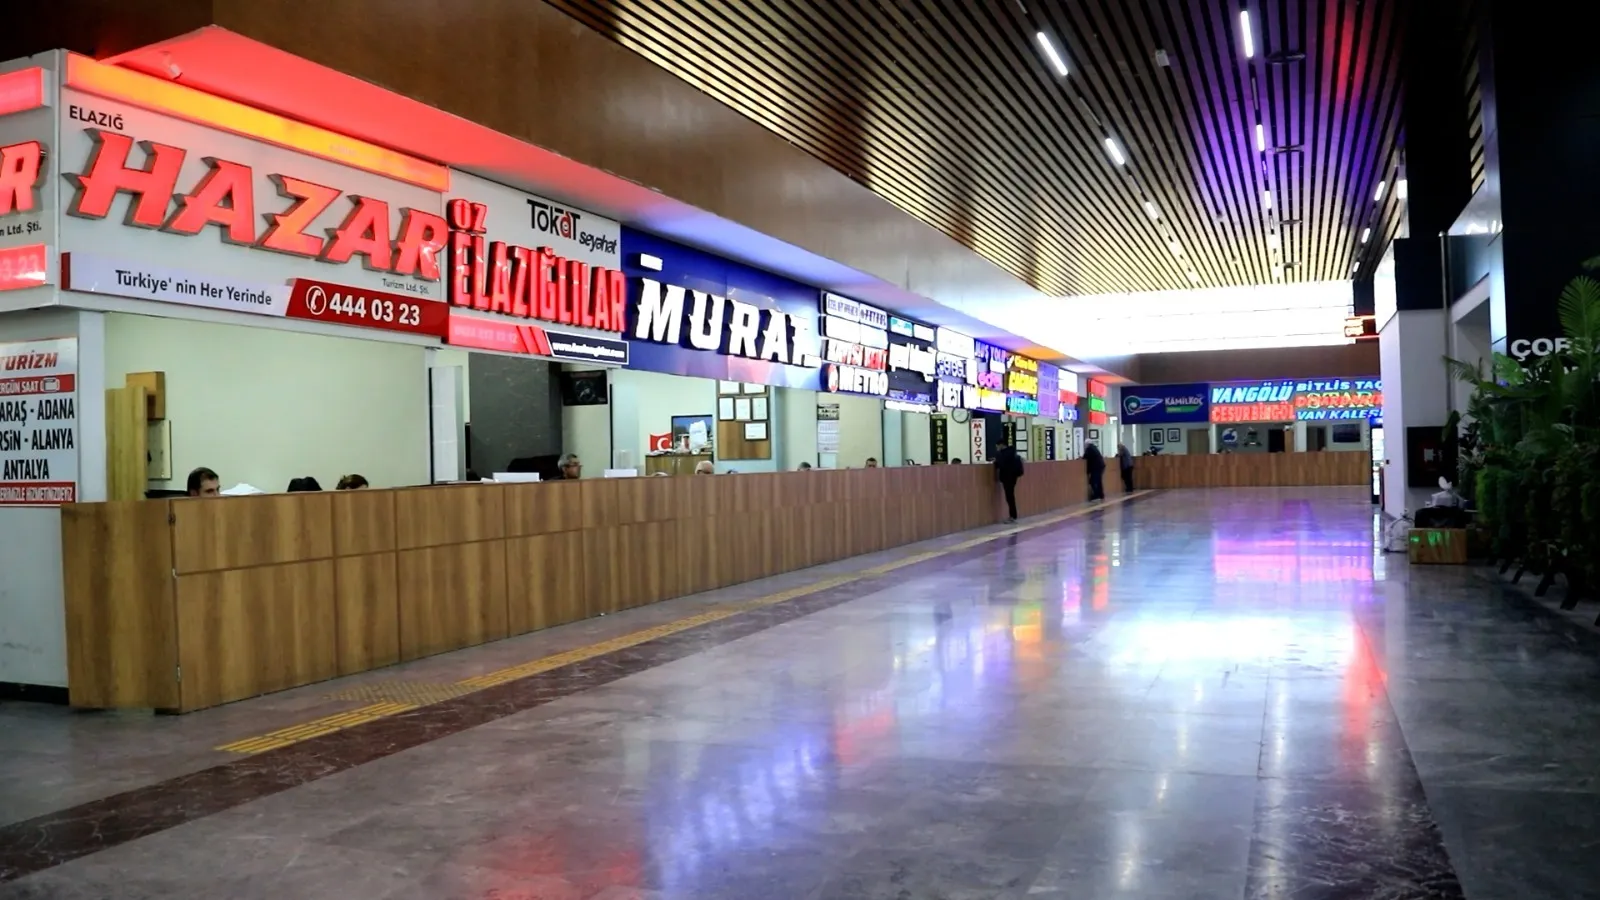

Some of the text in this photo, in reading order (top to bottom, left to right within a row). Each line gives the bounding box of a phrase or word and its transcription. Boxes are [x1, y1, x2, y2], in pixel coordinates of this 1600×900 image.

[69, 105, 124, 131] ELAZIĞ
[69, 127, 449, 281] HAZAR
[7, 223, 24, 236] Ltd.
[176, 280, 196, 295] nin
[200, 282, 223, 298] Her
[226, 286, 272, 305] Yerinde
[449, 231, 627, 333] ELAZIĞLILAR
[329, 292, 420, 326] 444 03 23
[839, 365, 888, 395] METRO
[1296, 380, 1351, 392] BİTLİS
[37, 398, 75, 421] ADANA
[31, 428, 74, 450] ALANYA
[3, 459, 50, 480] ANTALYA
